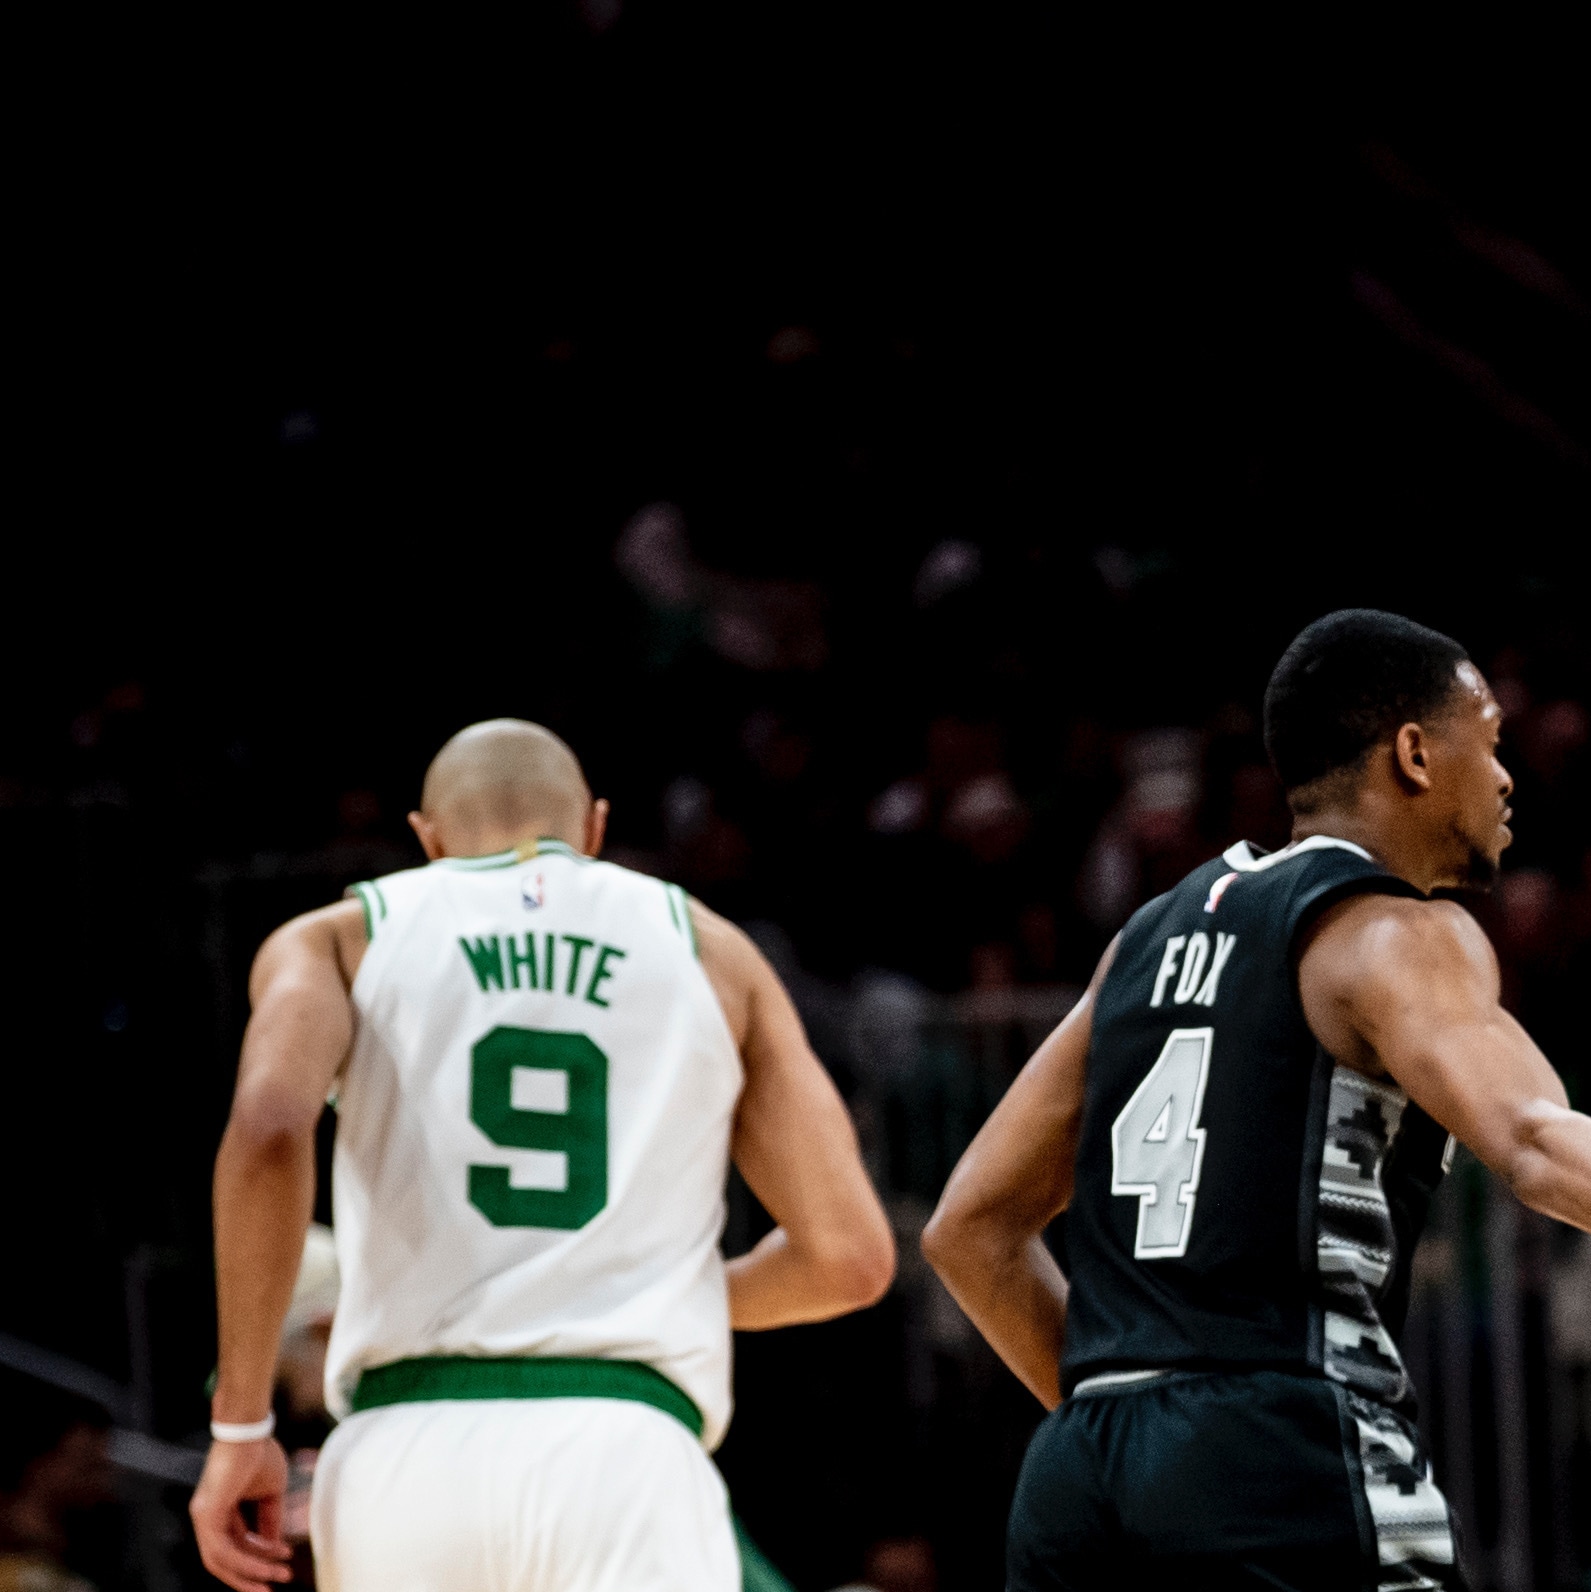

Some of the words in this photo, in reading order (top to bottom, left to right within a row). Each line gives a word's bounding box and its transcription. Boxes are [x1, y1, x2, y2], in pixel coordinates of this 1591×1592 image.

[458, 931, 627, 1009] WHITE
[1150, 931, 1237, 1007] FOX
[466, 1024, 609, 1231] 9
[1111, 1026, 1215, 1260] 4
